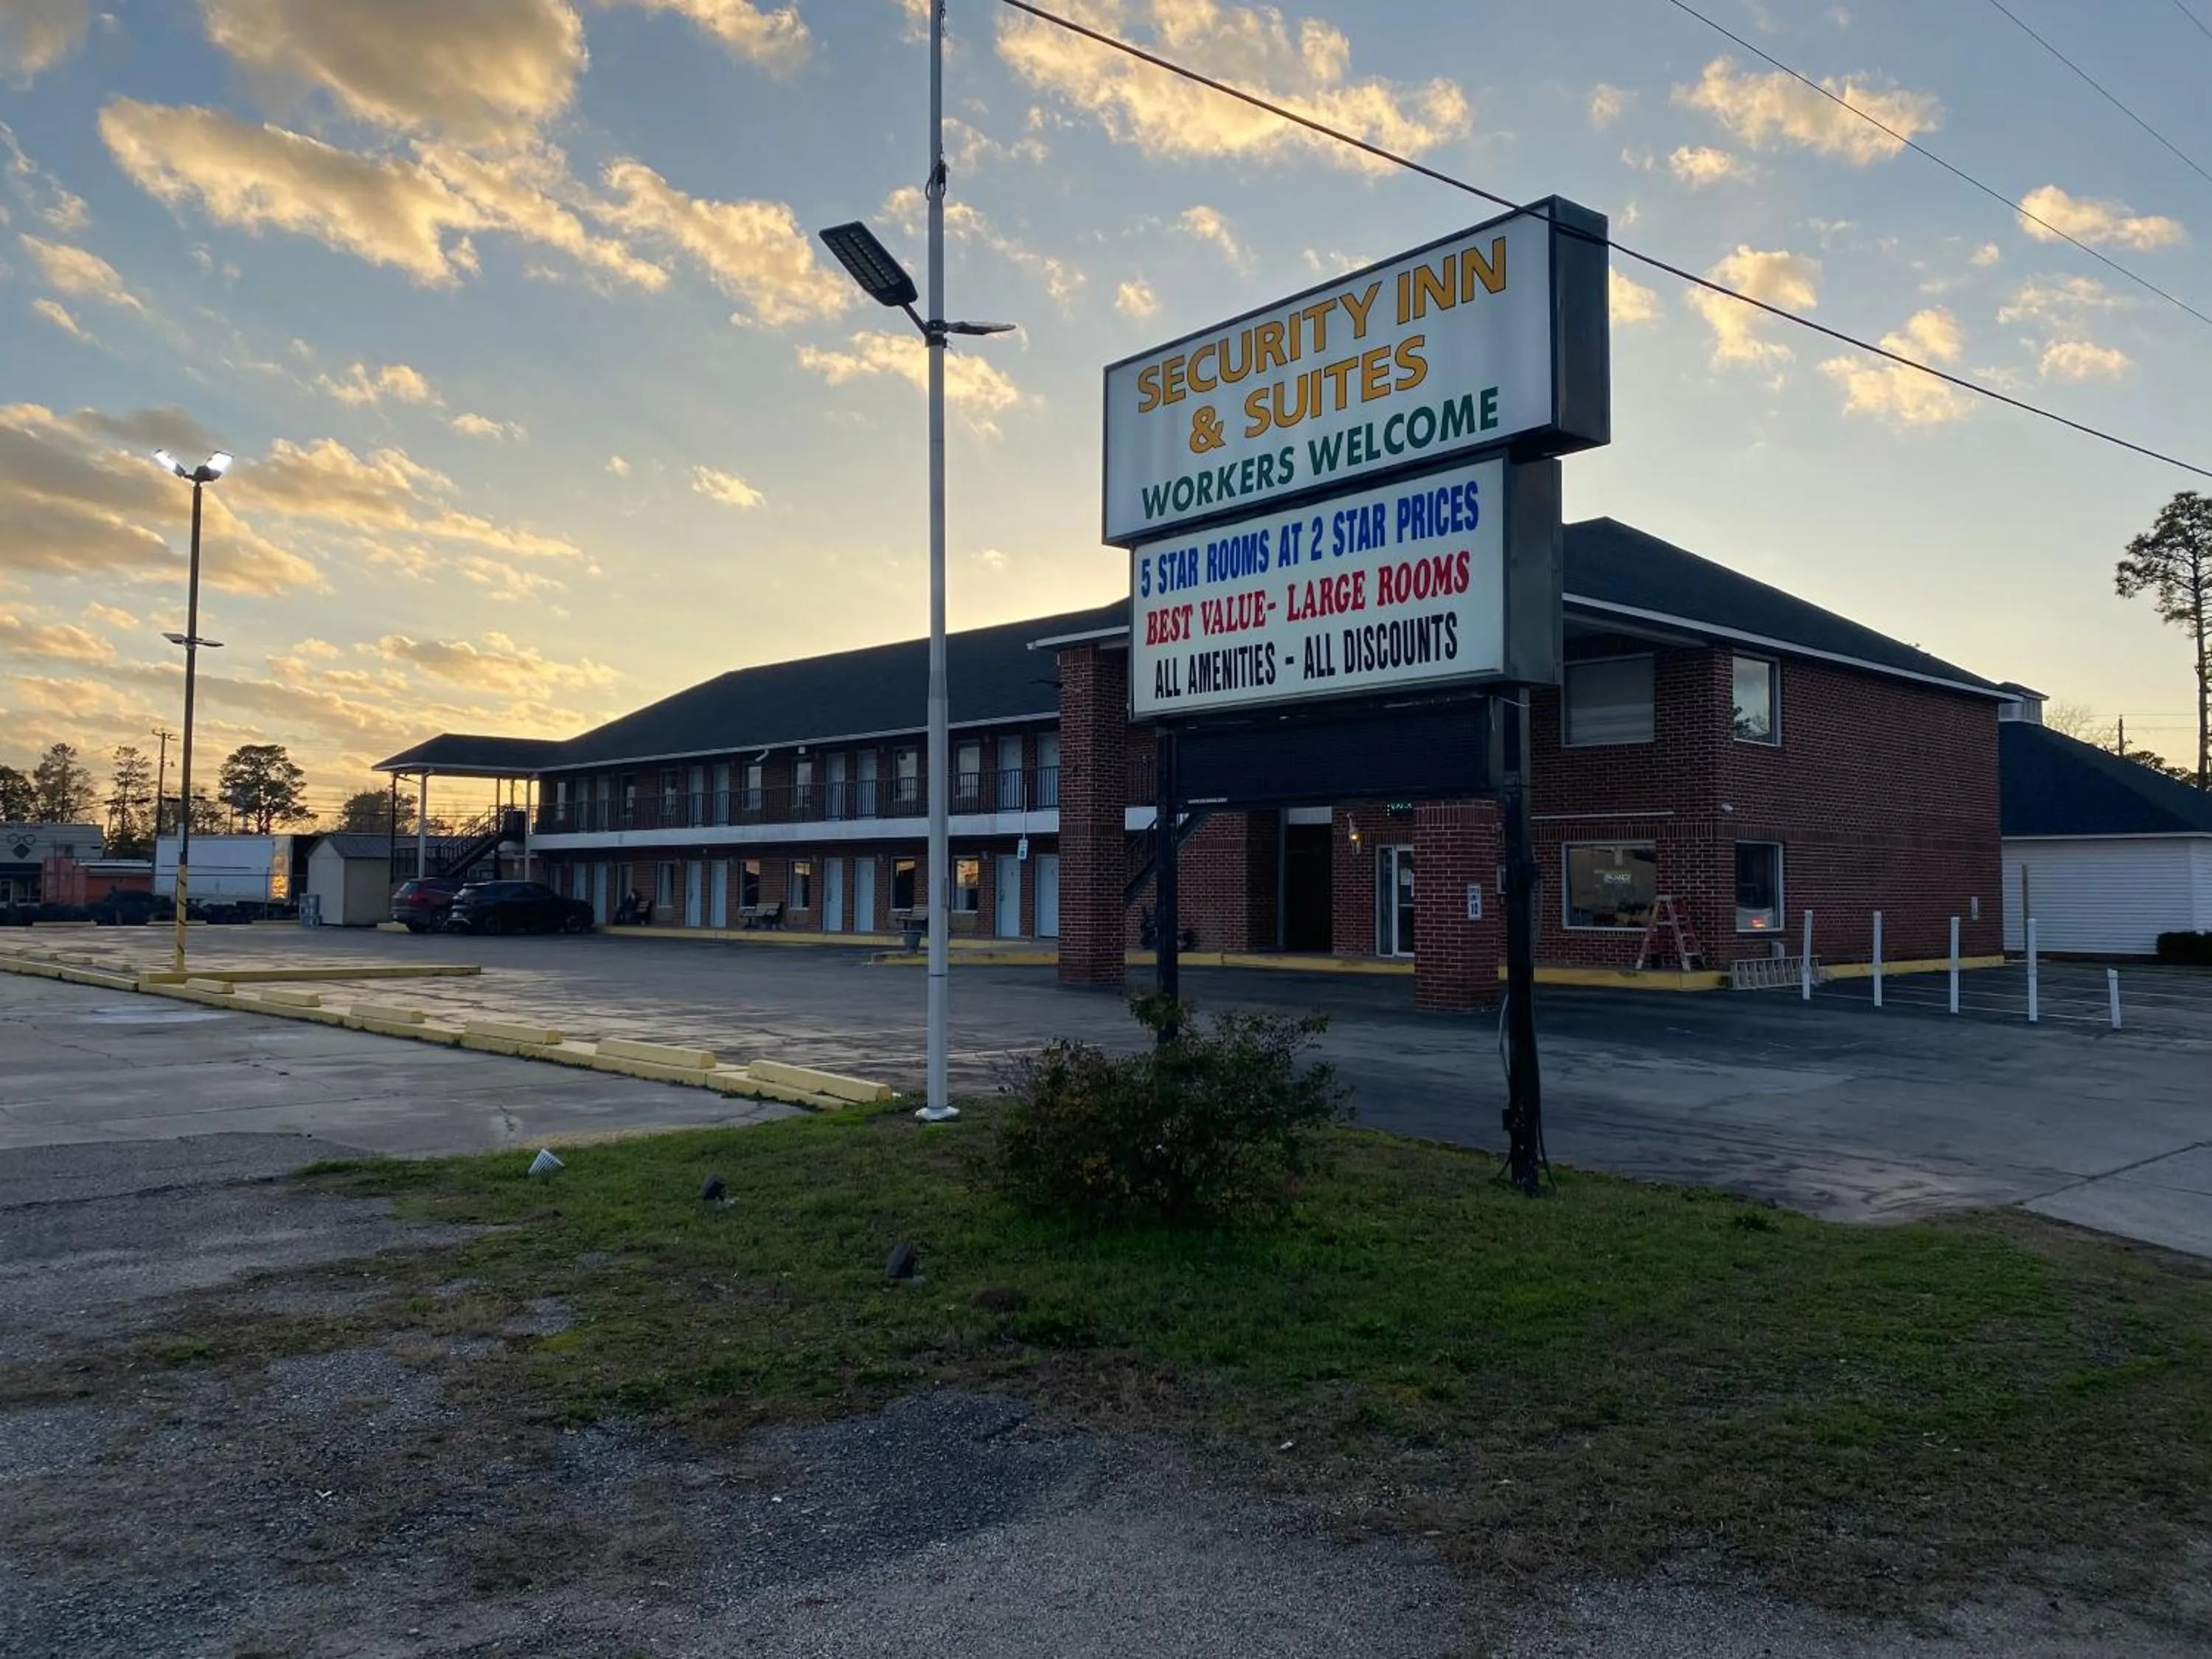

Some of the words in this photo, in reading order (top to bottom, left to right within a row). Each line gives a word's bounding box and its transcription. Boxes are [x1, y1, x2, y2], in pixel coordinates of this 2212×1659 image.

[1137, 281, 1381, 413] SECURITY
[1397, 236, 1506, 325] INN
[1141, 446, 1294, 519] WORKERS
[1310, 386, 1498, 476] WELCOME
[1189, 406, 1226, 454] &
[1244, 335, 1428, 439] SUITES
[1141, 558, 1151, 597] 5
[1158, 549, 1198, 594] STAR
[1206, 530, 1269, 585] ROOMS
[1278, 522, 1302, 568] AT
[1311, 517, 1323, 560] 2
[1332, 503, 1386, 556] STAR
[1397, 481, 1478, 543] PRICES
[1146, 604, 1193, 645] BEST
[1200, 590, 1276, 635] VALUE-
[1287, 570, 1366, 622] LARGE
[1377, 549, 1470, 605] ROOMS
[1155, 658, 1180, 699] ALL
[1188, 641, 1275, 693] AMENITIES
[1304, 633, 1335, 679] ALL
[1343, 611, 1458, 674] DISCOUNTS
